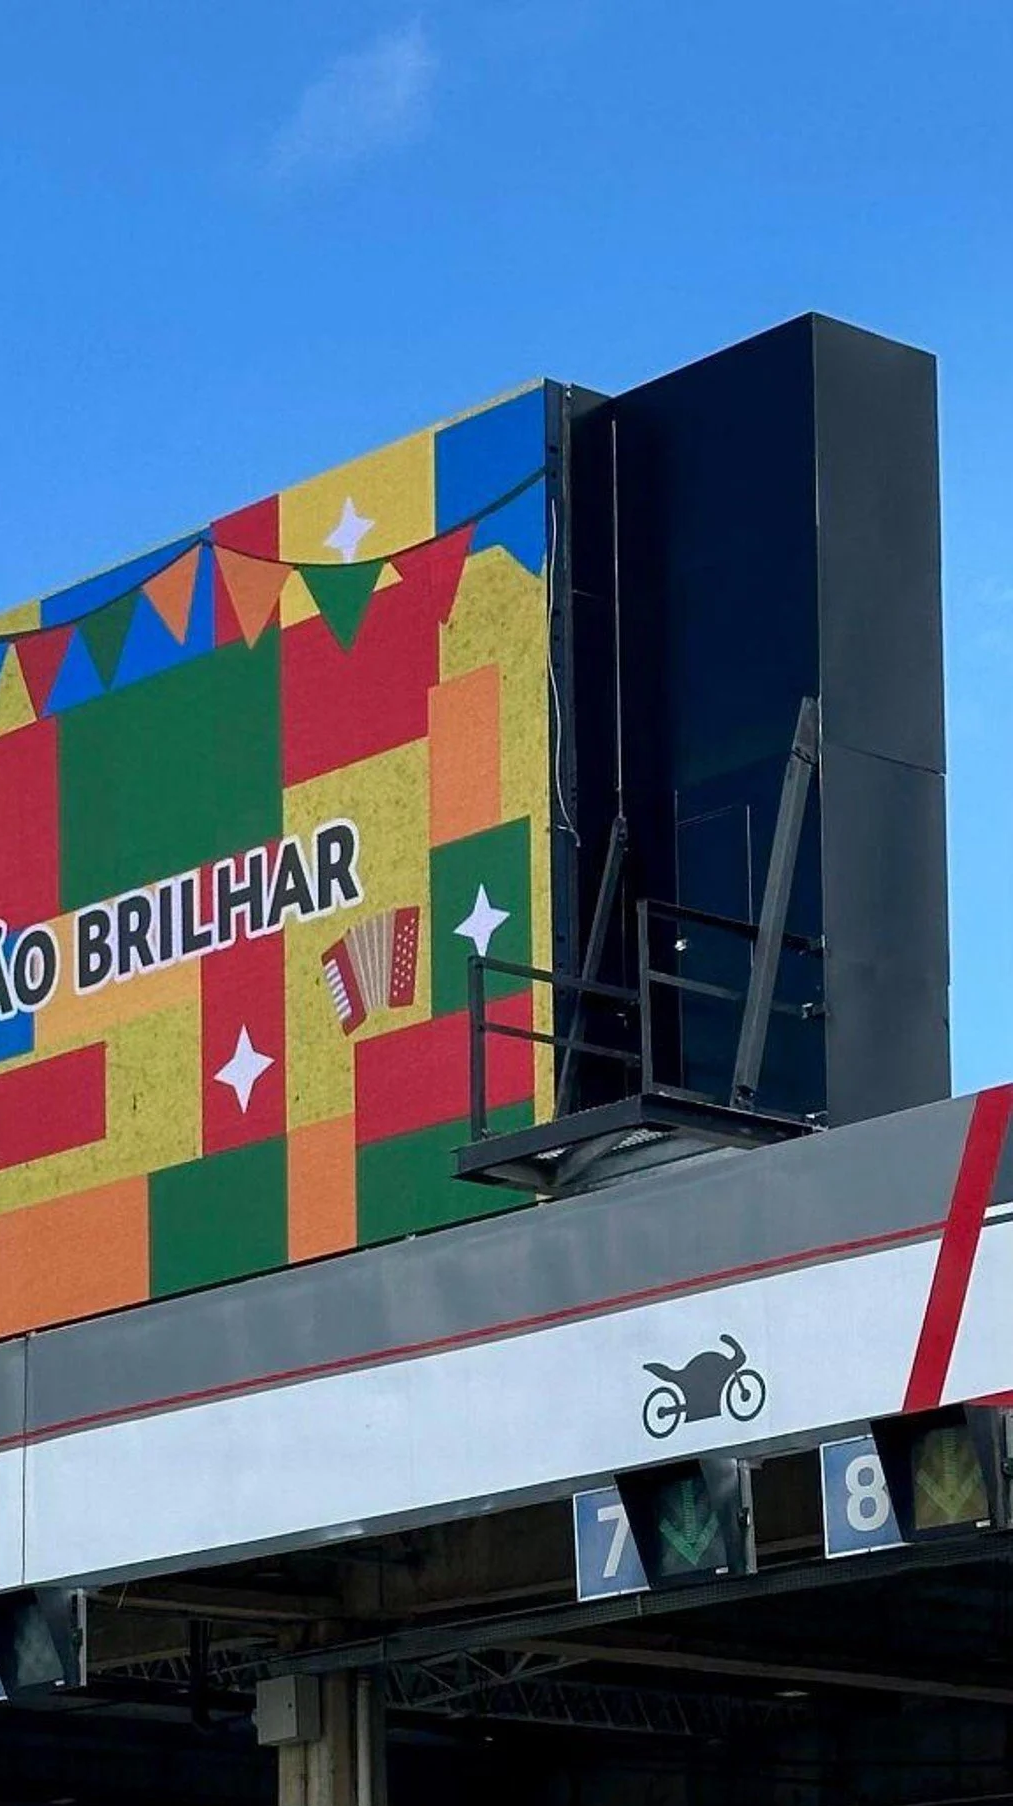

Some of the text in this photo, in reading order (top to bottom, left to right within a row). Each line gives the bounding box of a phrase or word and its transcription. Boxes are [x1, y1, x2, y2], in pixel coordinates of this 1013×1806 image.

[78, 825, 358, 990] BRILHAR
[846, 1454, 890, 1532] 8
[597, 1506, 632, 1579] 7
